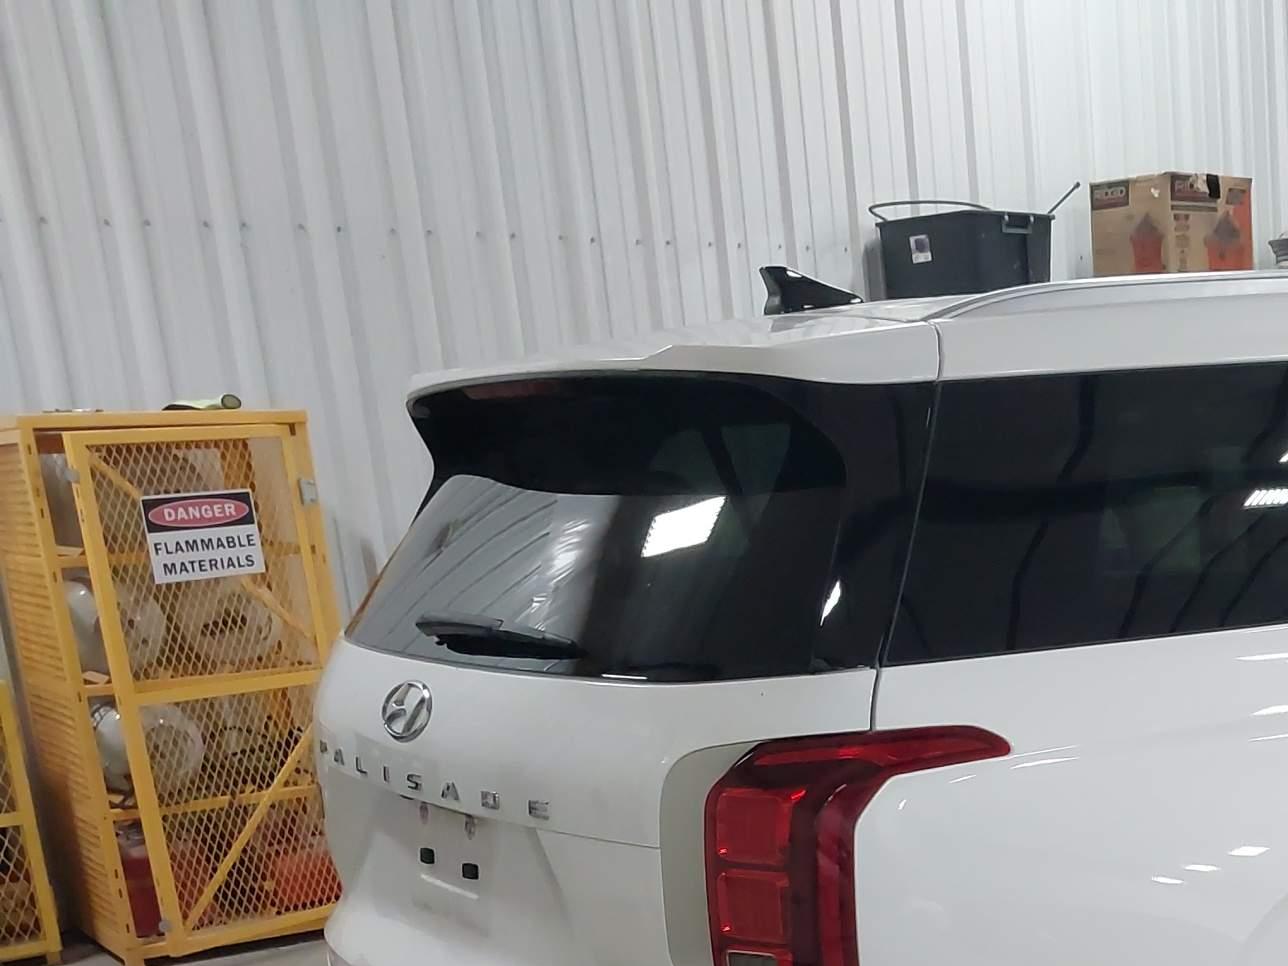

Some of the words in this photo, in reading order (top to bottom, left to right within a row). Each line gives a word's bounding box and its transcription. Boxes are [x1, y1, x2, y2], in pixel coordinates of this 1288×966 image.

[163, 503, 237, 522] DANGER
[153, 533, 257, 556] FLAMMABLE
[162, 554, 256, 577] MATERIALS
[319, 739, 550, 821] PALISADE
